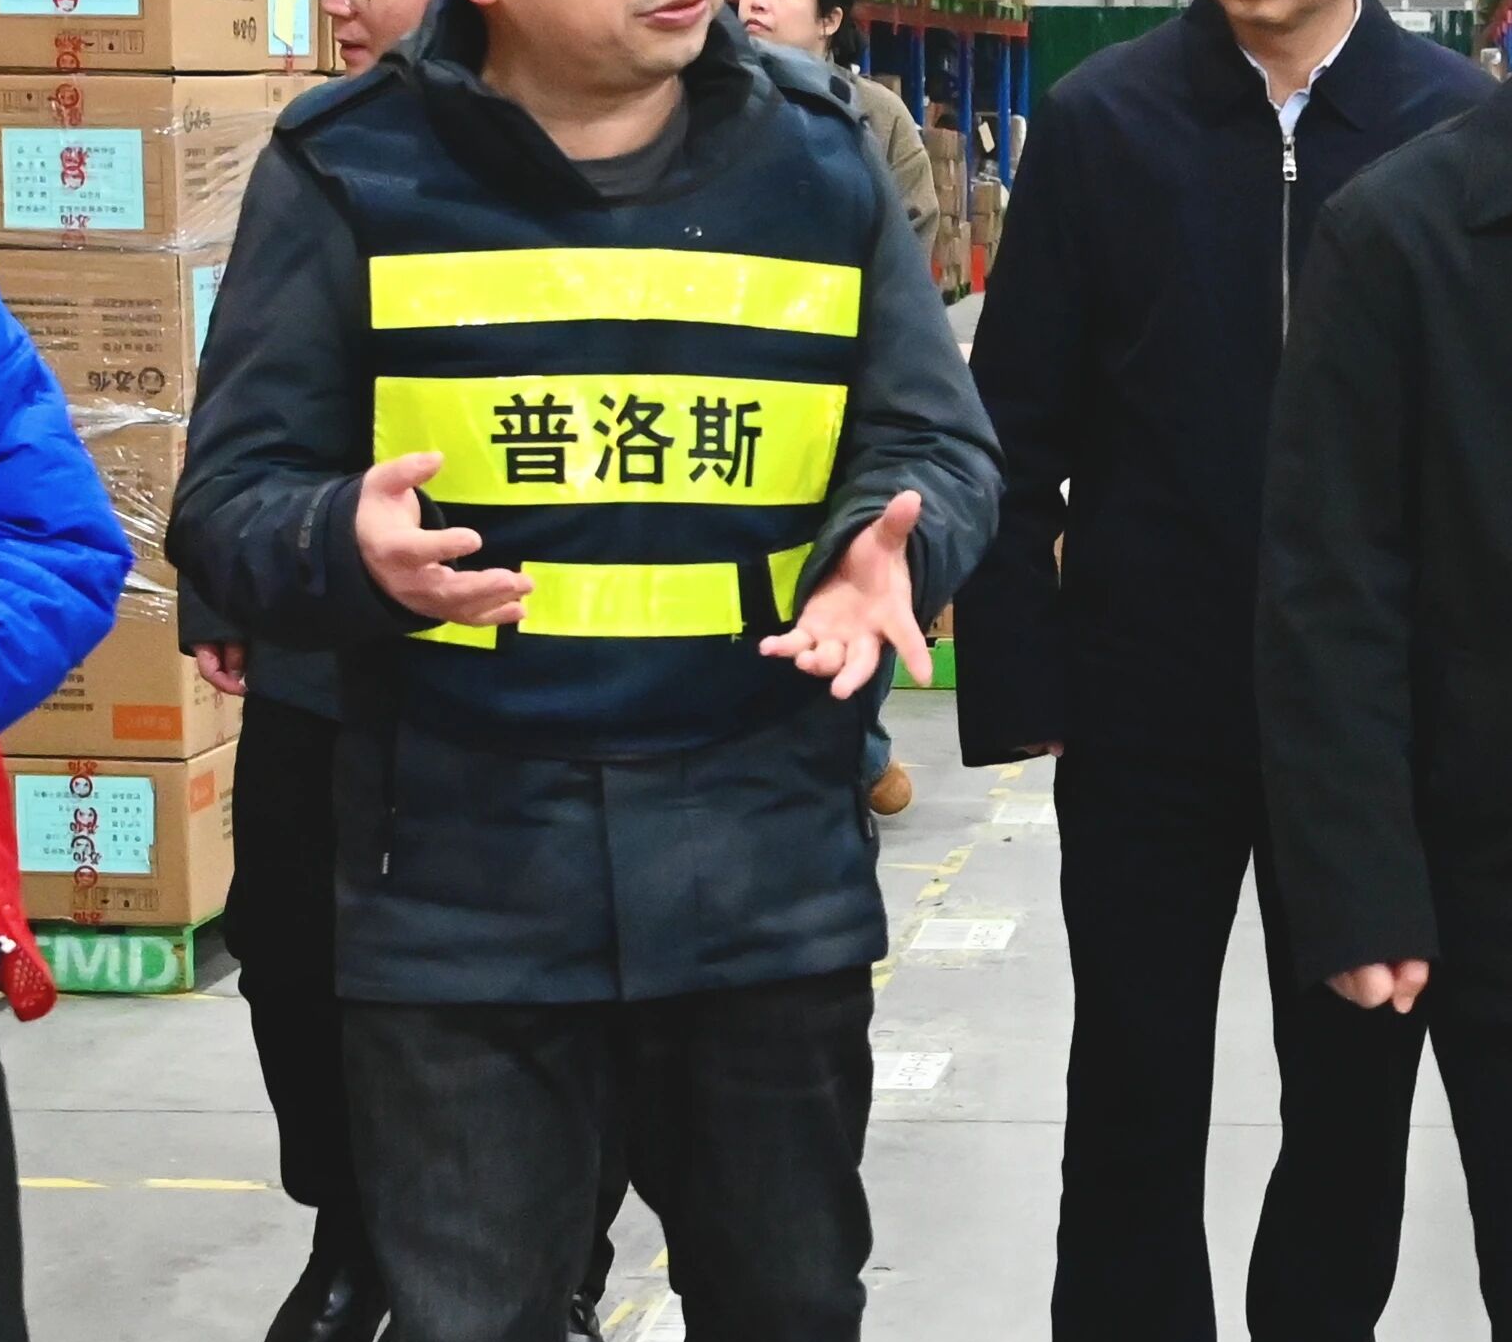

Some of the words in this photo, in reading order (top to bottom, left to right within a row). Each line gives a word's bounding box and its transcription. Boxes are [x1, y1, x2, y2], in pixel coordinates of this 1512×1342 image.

[490, 391, 766, 489] 普洛斯
[39, 933, 180, 987] MD
